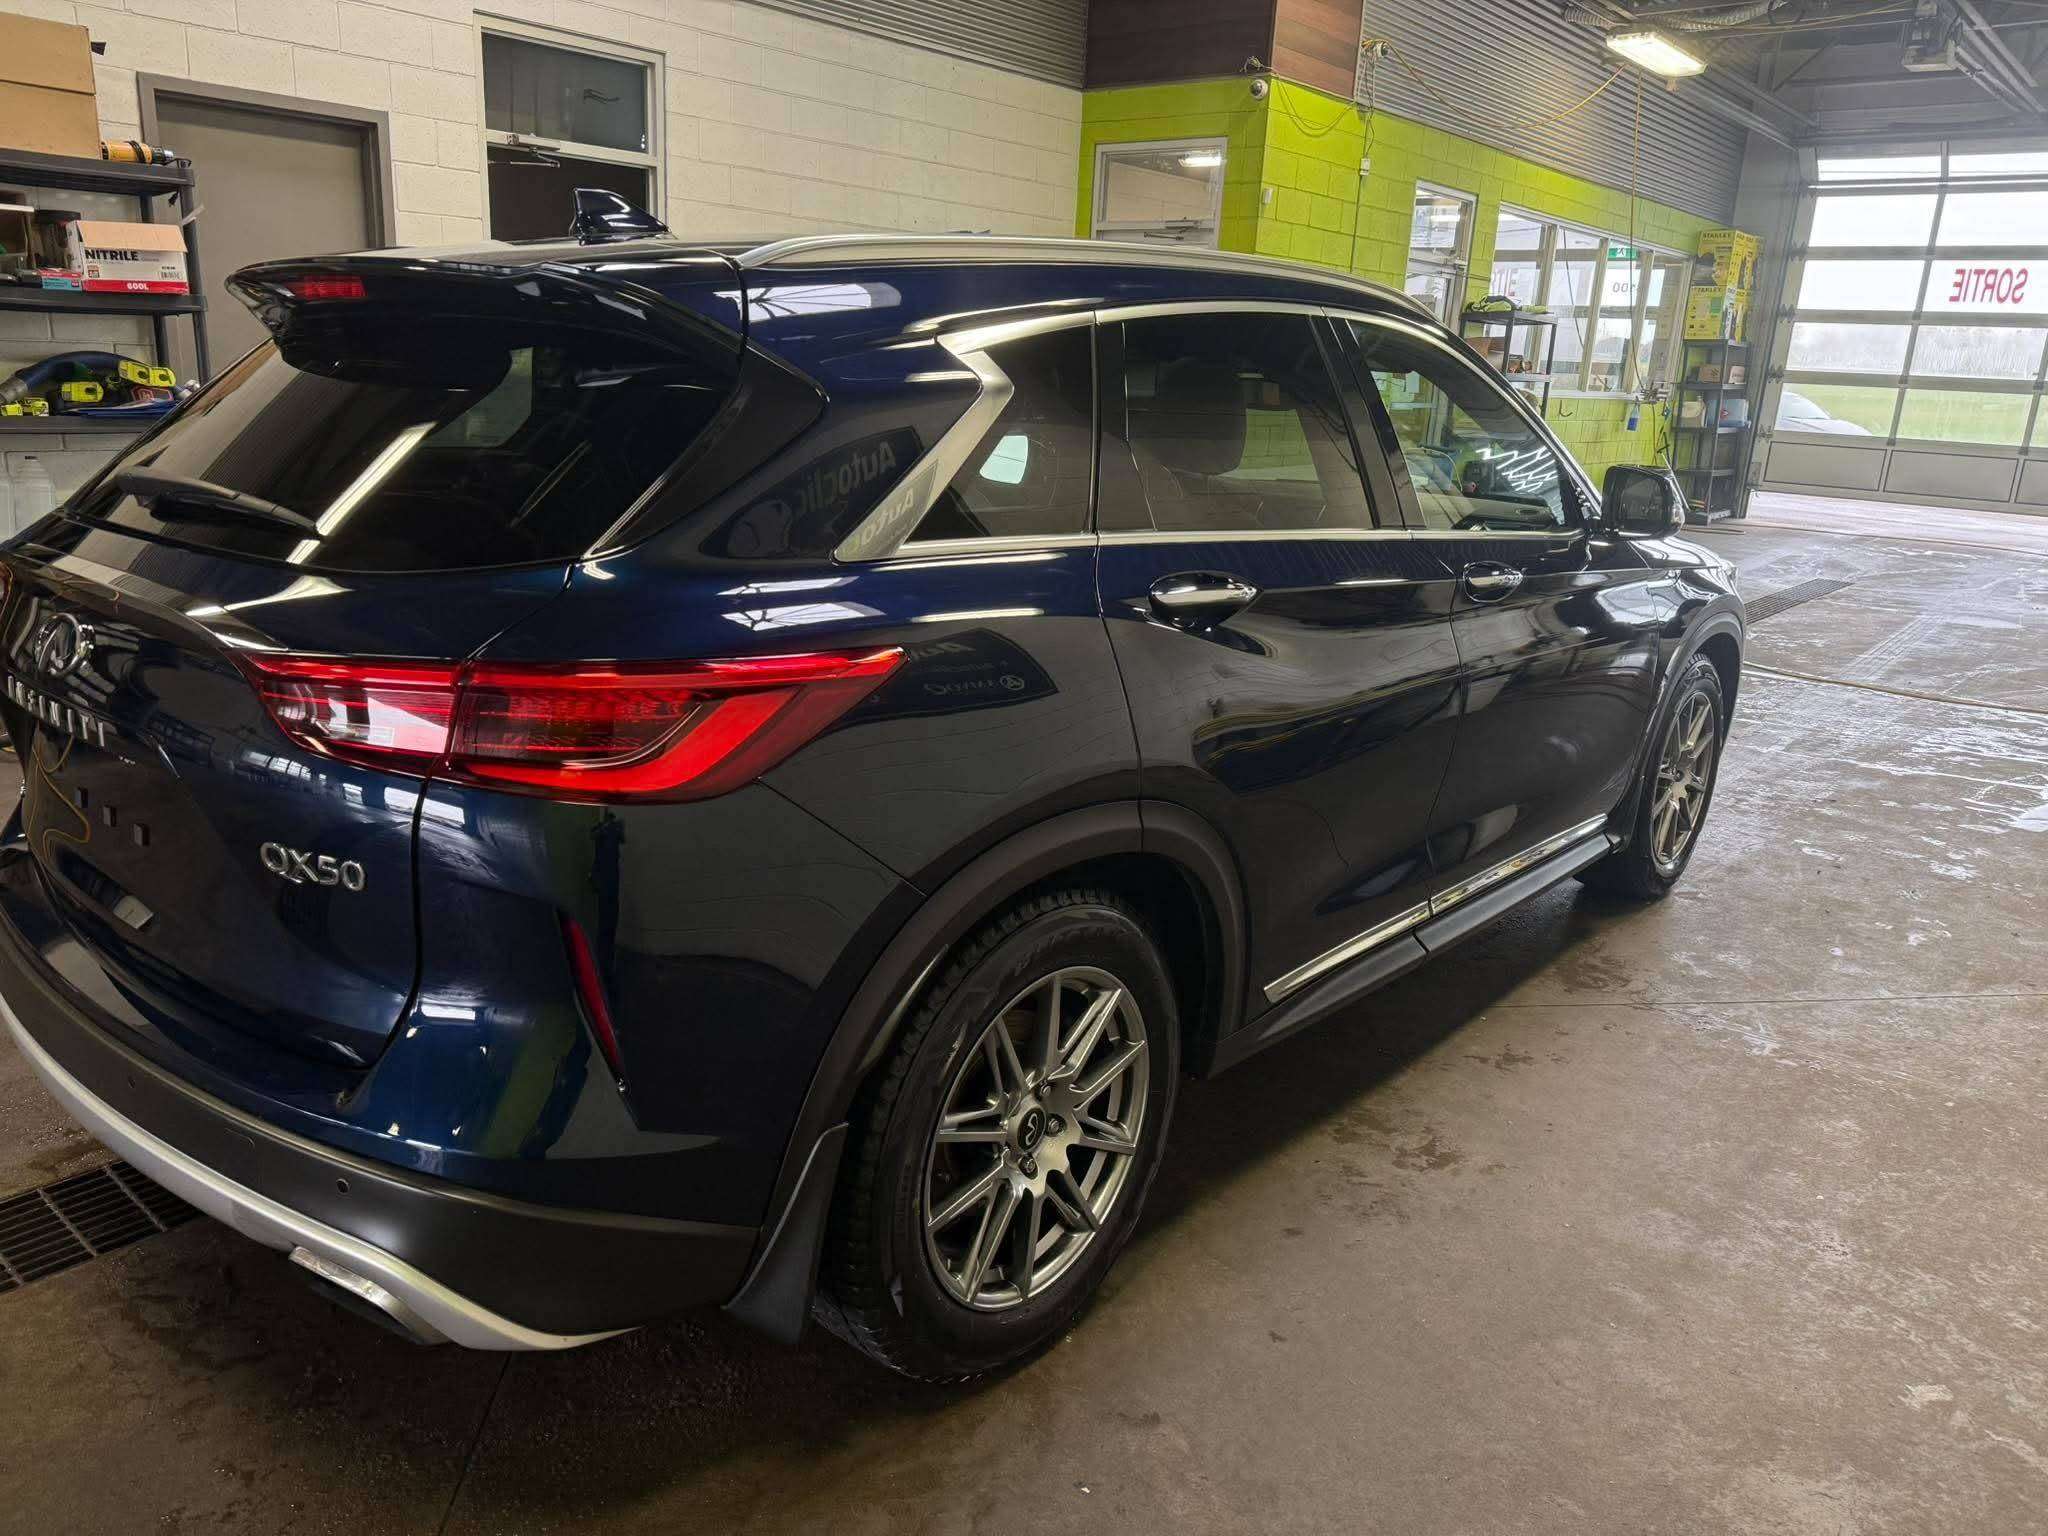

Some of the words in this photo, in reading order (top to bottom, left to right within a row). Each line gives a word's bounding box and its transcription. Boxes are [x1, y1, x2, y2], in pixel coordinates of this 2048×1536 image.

[85, 249, 139, 261] NITRILE
[127, 282, 149, 290] 600L
[260, 842, 365, 891] QX50
